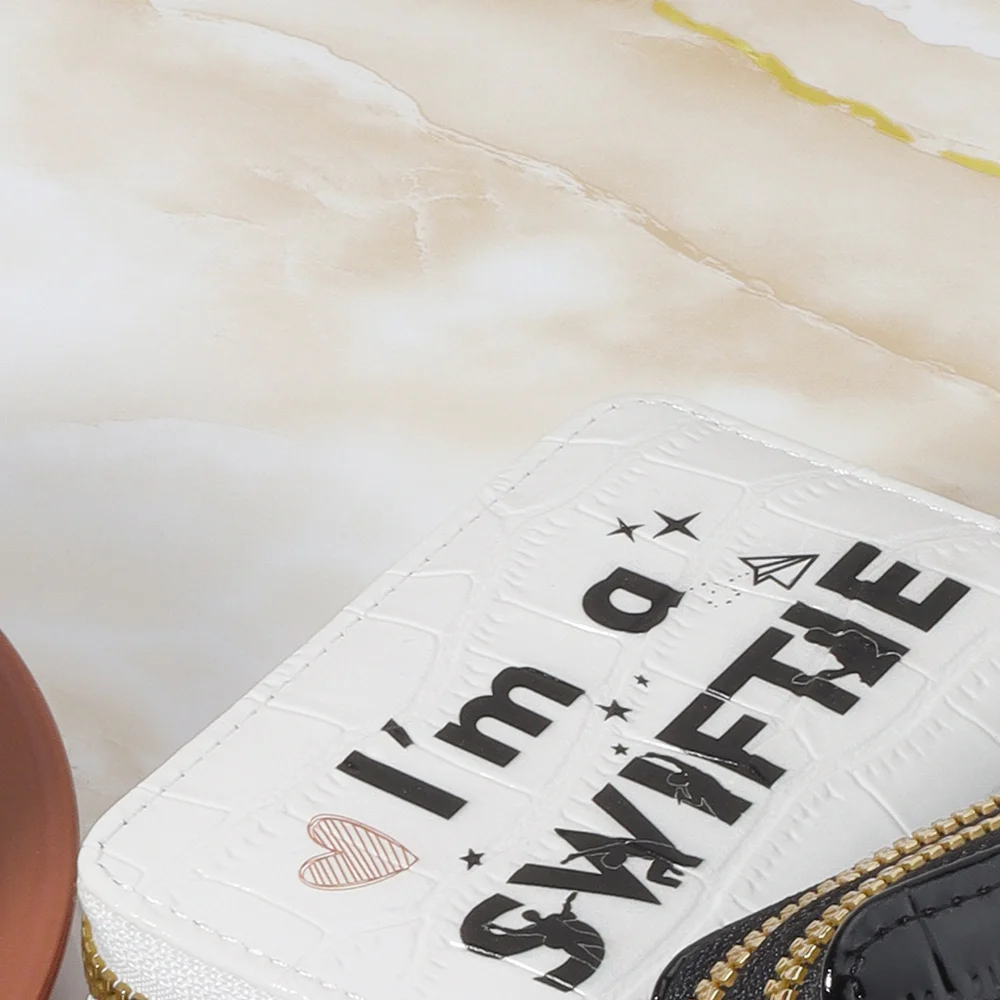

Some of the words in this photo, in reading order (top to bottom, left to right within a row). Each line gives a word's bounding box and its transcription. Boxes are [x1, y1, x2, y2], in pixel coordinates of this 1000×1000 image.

[337, 666, 585, 819] I'm
[582, 567, 686, 633] a
[460, 541, 971, 991] SWIFTIE
